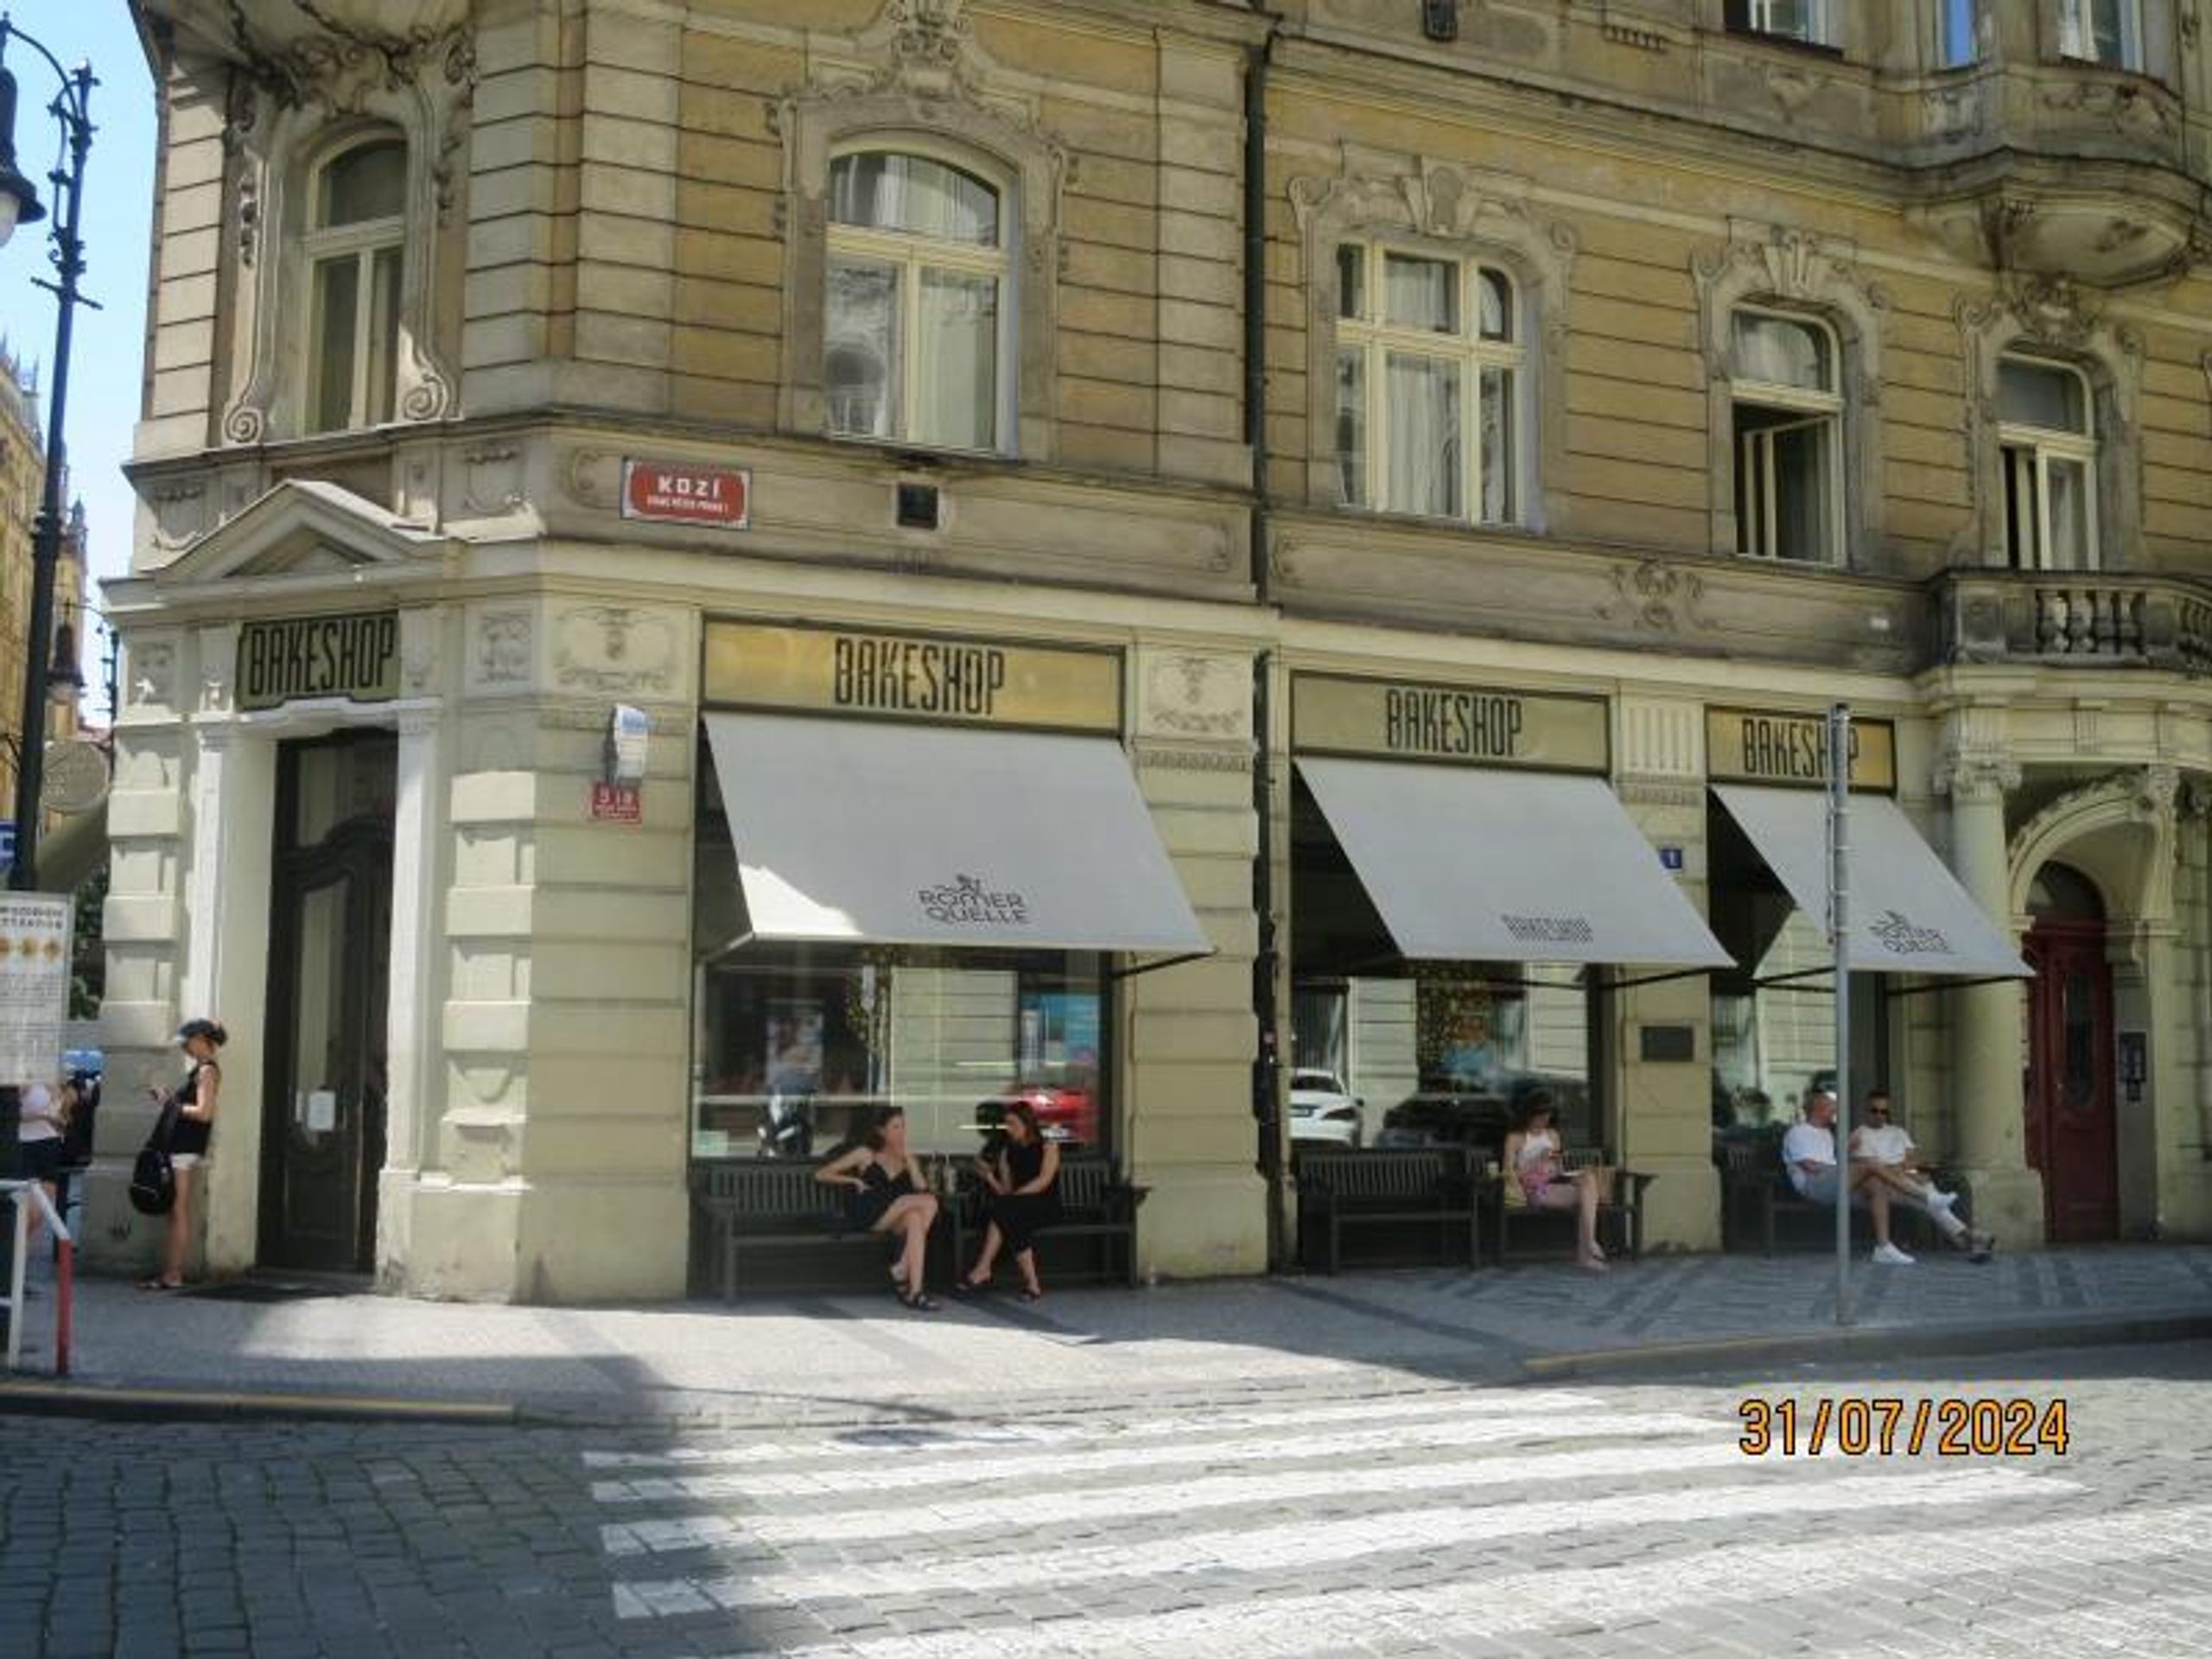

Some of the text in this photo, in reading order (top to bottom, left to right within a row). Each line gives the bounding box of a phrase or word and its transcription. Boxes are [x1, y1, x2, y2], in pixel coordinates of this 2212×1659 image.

[250, 616, 394, 695] BAKESHOP
[835, 637, 1005, 715] BAKESHOP
[1387, 689, 1522, 757] BAKESHOP
[1742, 718, 1859, 780] BAKESHP
